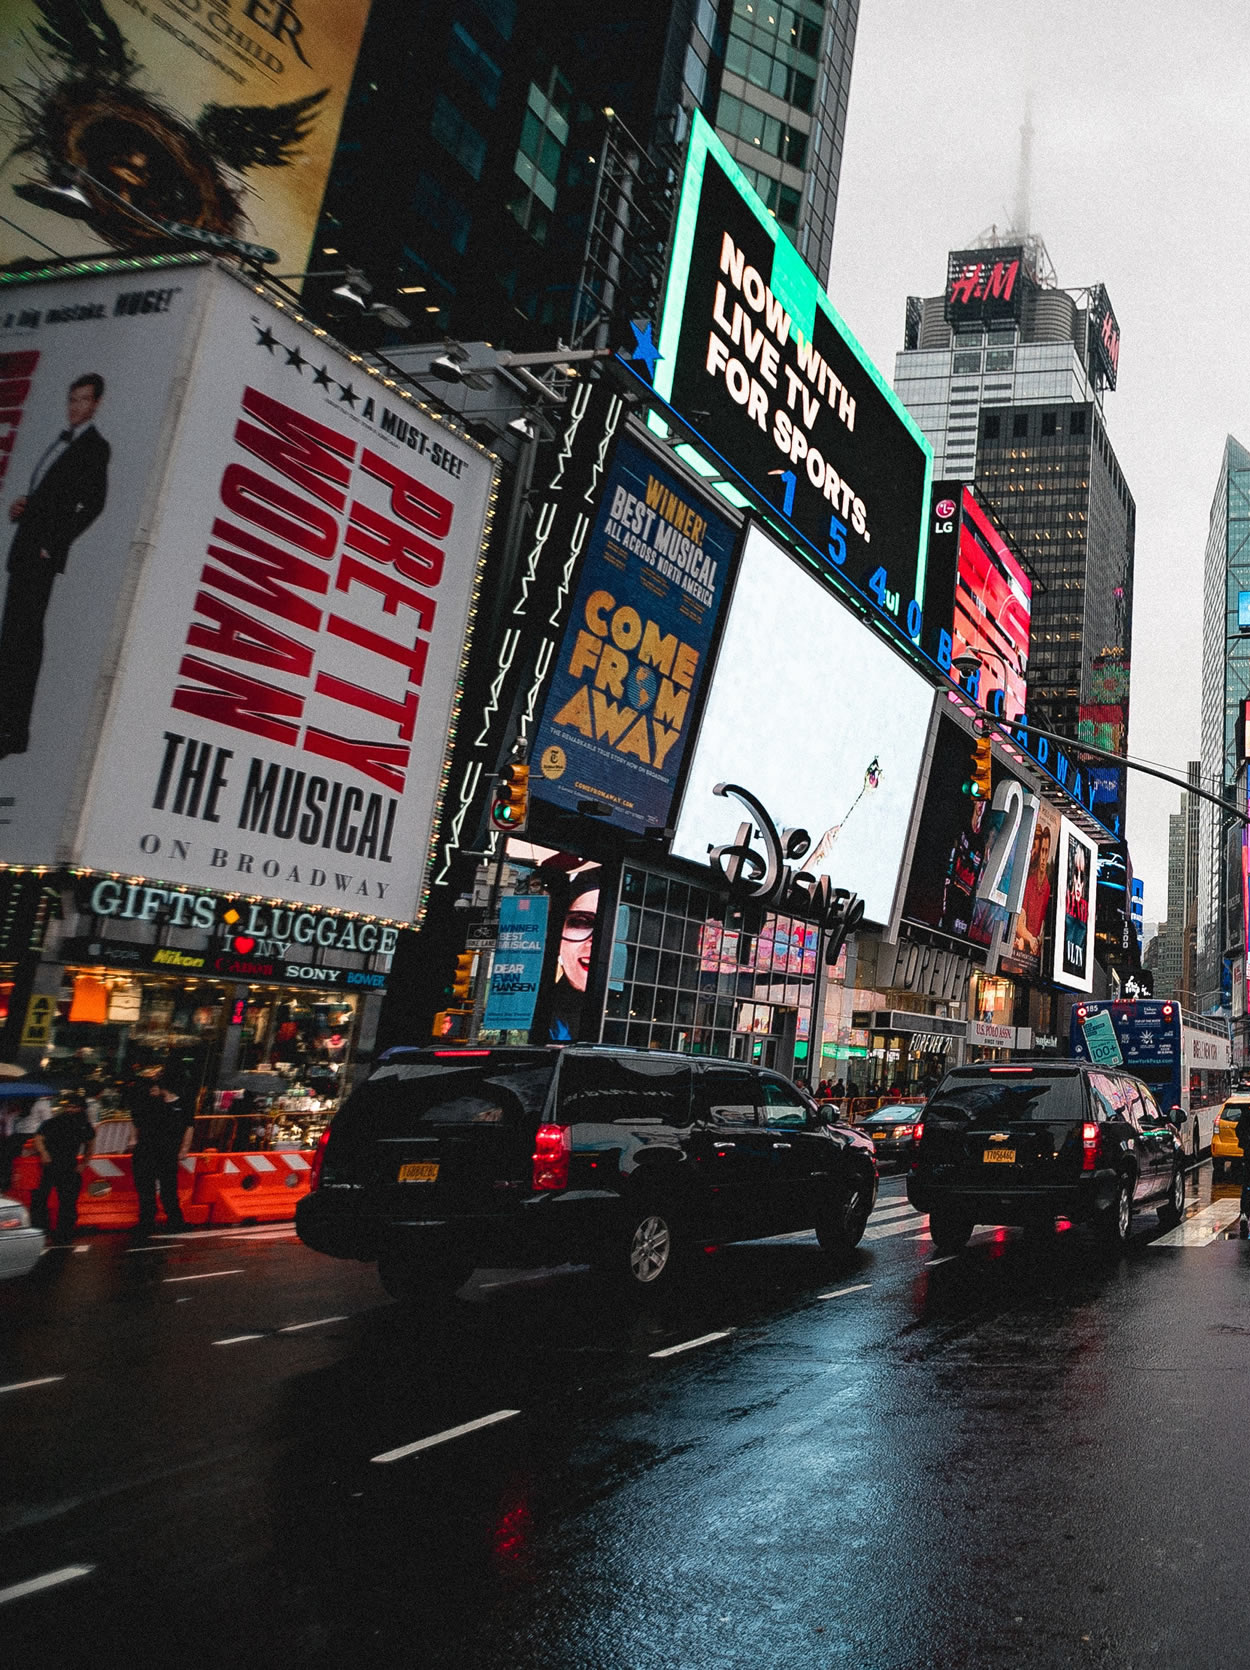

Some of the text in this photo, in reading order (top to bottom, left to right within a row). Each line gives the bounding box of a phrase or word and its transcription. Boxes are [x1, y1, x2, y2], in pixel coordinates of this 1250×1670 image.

[950, 260, 1020, 304] H&M
[719, 231, 856, 432] NOW WITH
[713, 280, 820, 430] LIVE TV
[363, 397, 376, 422] A
[706, 331, 871, 543] FOR SPORTS.
[645, 474, 708, 547] WINNER!
[935, 522, 953, 534] LG
[610, 484, 656, 542] BEST
[653, 519, 717, 593] MUSICAL
[171, 385, 359, 746] WOMAN
[604, 518, 621, 543] ALL
[622, 531, 657, 566] ACROSS
[656, 553, 683, 586] NORTH
[681, 574, 713, 609] AMERICA
[302, 447, 455, 795] PRETTY
[585, 590, 700, 690] COME
[552, 684, 681, 770] AWAY
[152, 731, 399, 863] THE MUSICAL
[140, 833, 391, 900] ON BROADWAY
[91, 880, 400, 957] GIFTS LUGGAGE
[500, 924, 539, 933] WINNER
[500, 932, 525, 941] BEST
[152, 949, 205, 969] Nikon
[215, 957, 274, 976] Canon
[498, 941, 542, 950] MUSICAL
[285, 964, 341, 983] SONY
[347, 971, 385, 988] BOWER
[491, 982, 537, 993] HANSEN
[493, 973, 520, 983] EVAN
[494, 963, 525, 975] DEAR
[27, 997, 50, 1039] ATM
[909, 1033, 945, 1053] FOREVER
[1092, 1045, 1116, 1059] 100+
